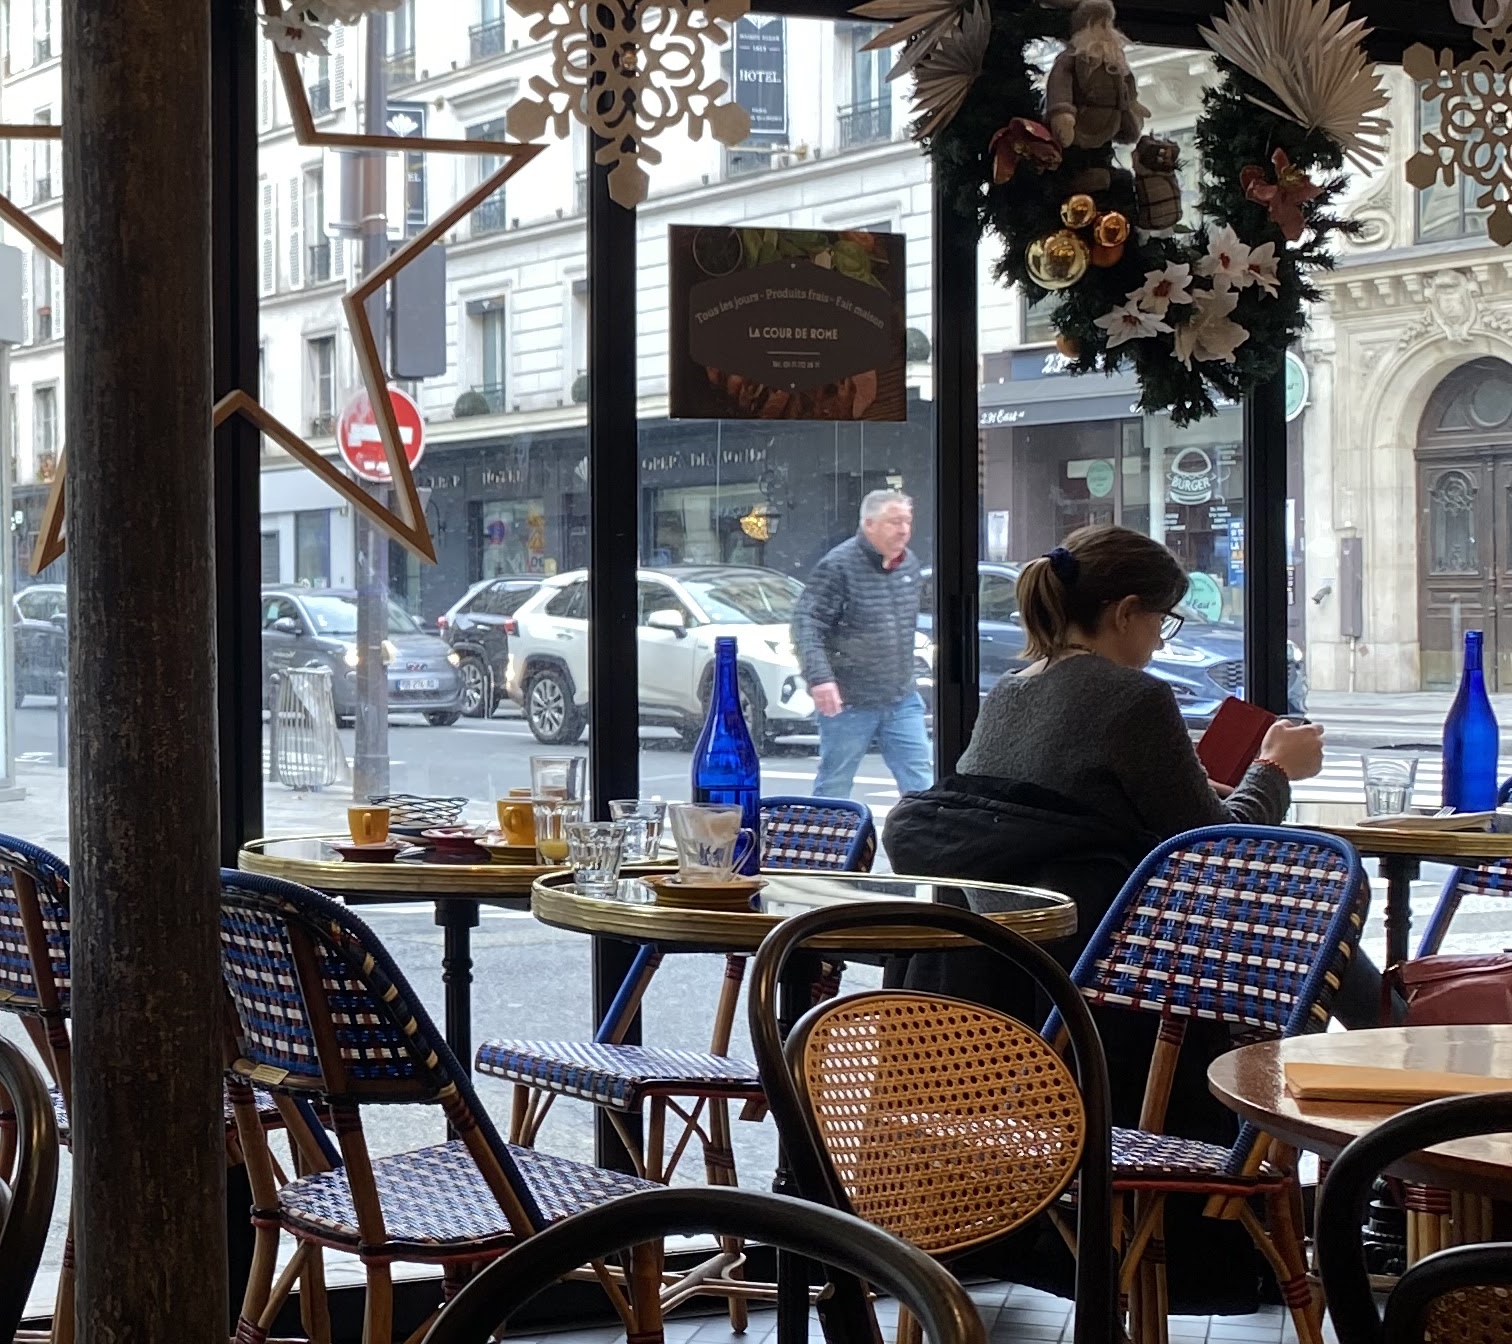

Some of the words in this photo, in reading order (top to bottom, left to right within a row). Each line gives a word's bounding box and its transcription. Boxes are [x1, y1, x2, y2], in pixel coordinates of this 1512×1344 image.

[740, 69, 782, 83] HOTEL
[695, 308, 719, 324] Tous
[720, 301, 734, 313] les
[734, 294, 759, 310] jours
[766, 288, 807, 300] Produits
[808, 289, 830, 303] frais
[835, 295, 853, 312] Fait
[854, 306, 885, 330] maison
[749, 327, 760, 338] LA
[762, 327, 793, 339] COUR
[795, 327, 807, 339] DE
[810, 328, 839, 340] ROME
[1172, 476, 1211, 492] BURGER
